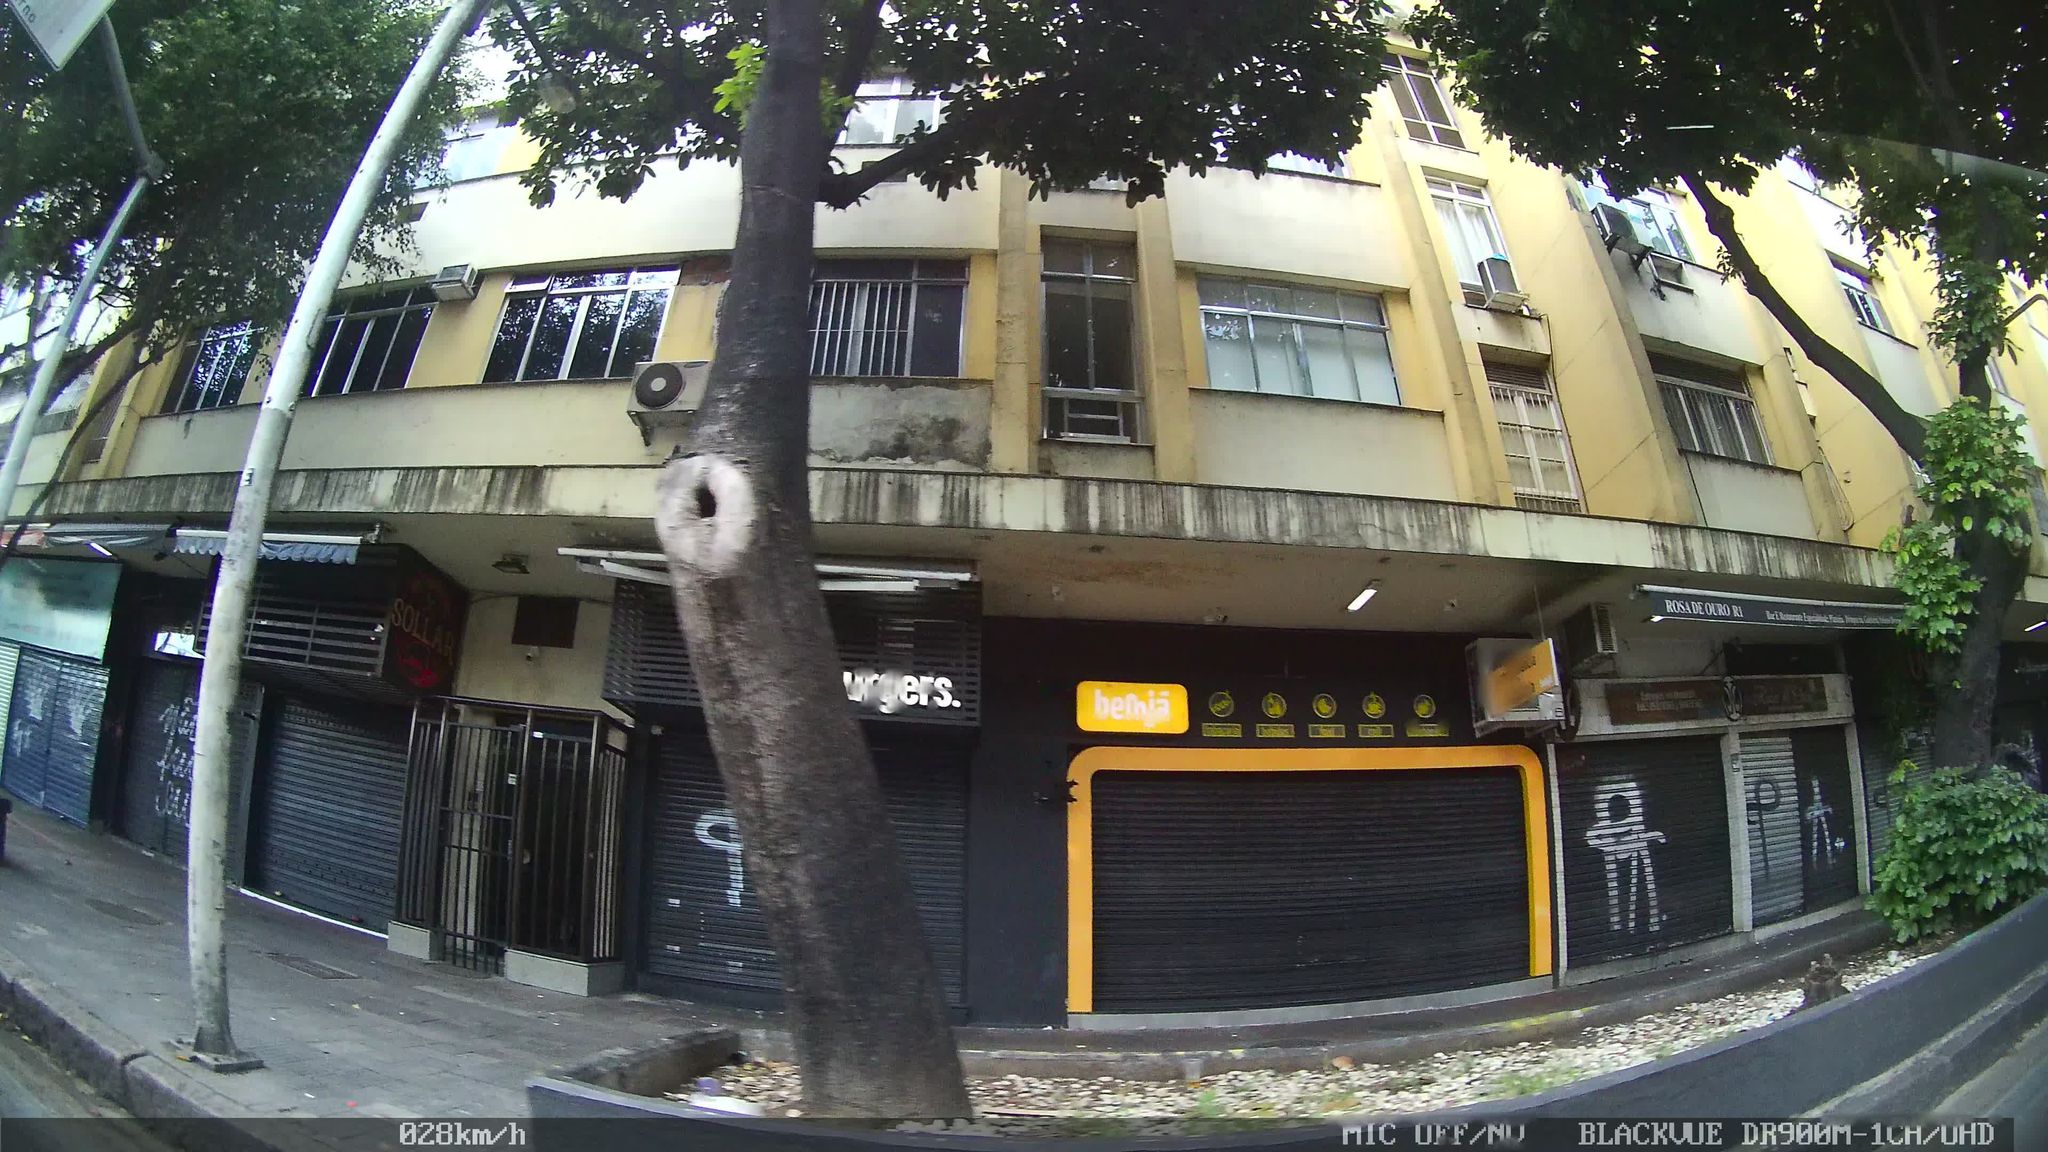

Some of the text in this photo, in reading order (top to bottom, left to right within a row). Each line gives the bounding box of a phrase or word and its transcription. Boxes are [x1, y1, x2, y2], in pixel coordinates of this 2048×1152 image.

[1664, 599, 1692, 614] ROSA
[1691, 601, 1705, 615] DE
[1704, 602, 1731, 617] OURO
